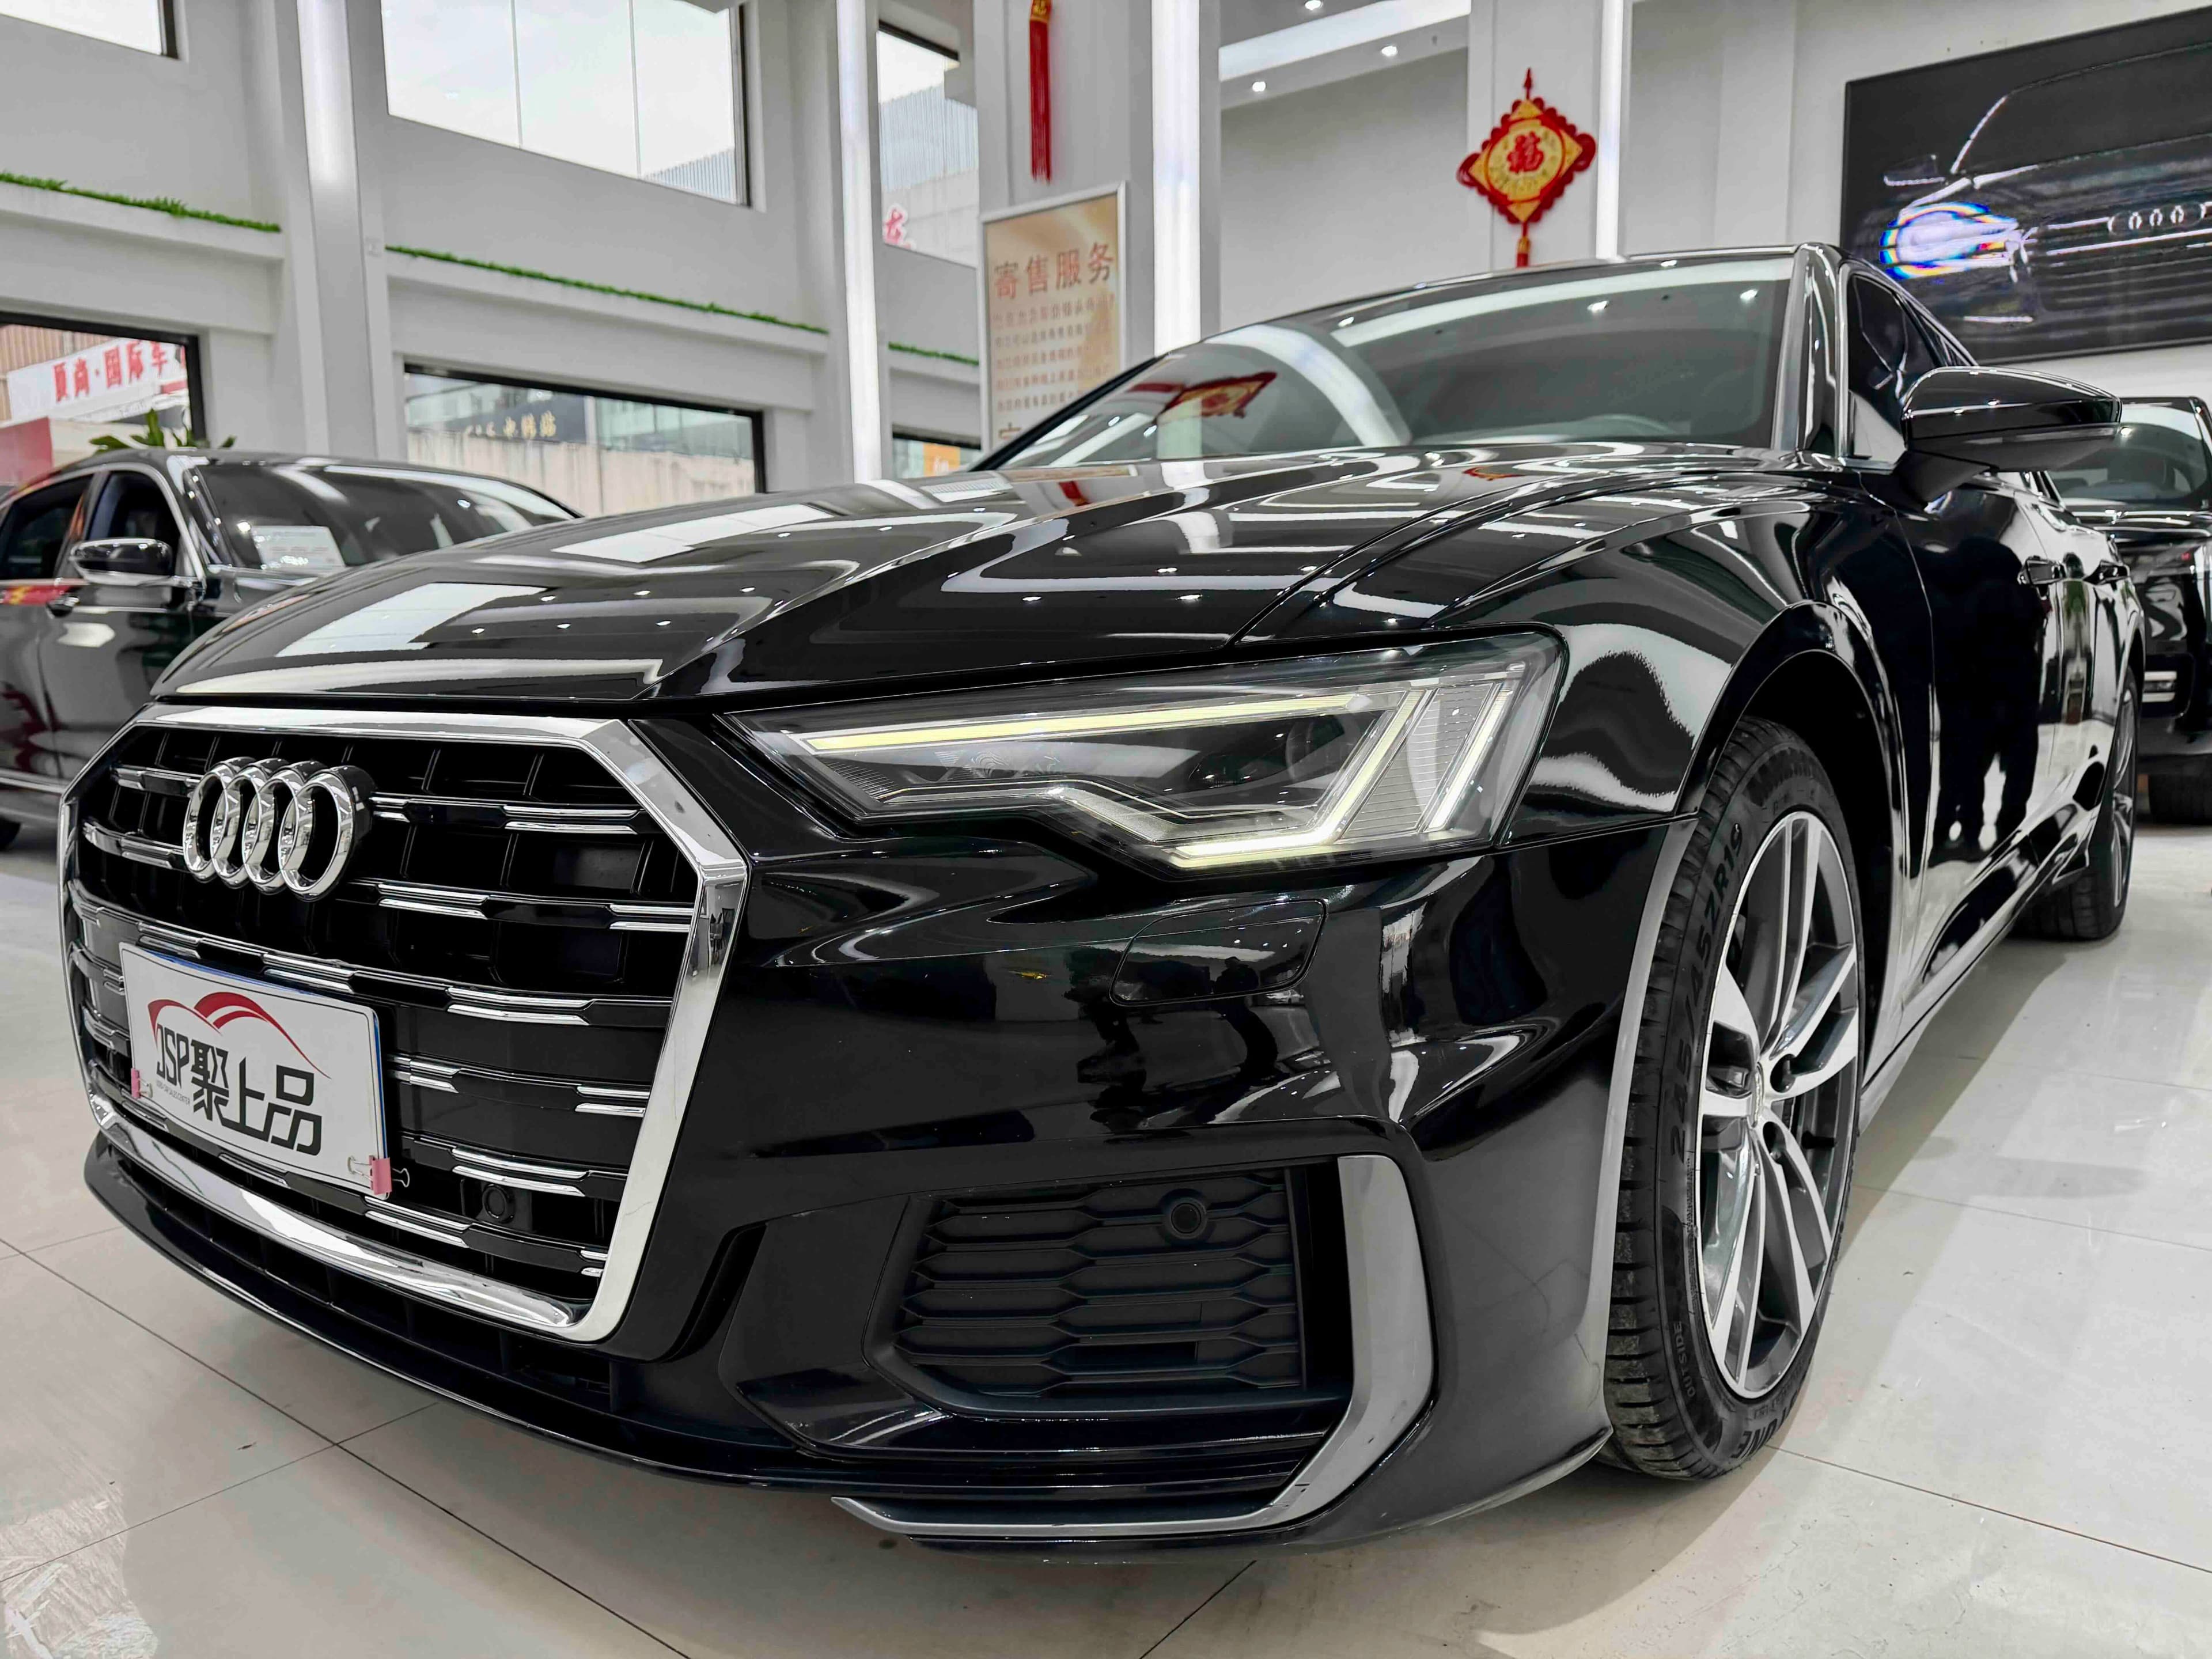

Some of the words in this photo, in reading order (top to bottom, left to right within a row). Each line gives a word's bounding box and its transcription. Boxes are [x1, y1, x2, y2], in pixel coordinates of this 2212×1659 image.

[995, 242, 1113, 300] 寄售服务
[1673, 1321, 1695, 1397] OUTSIDE
